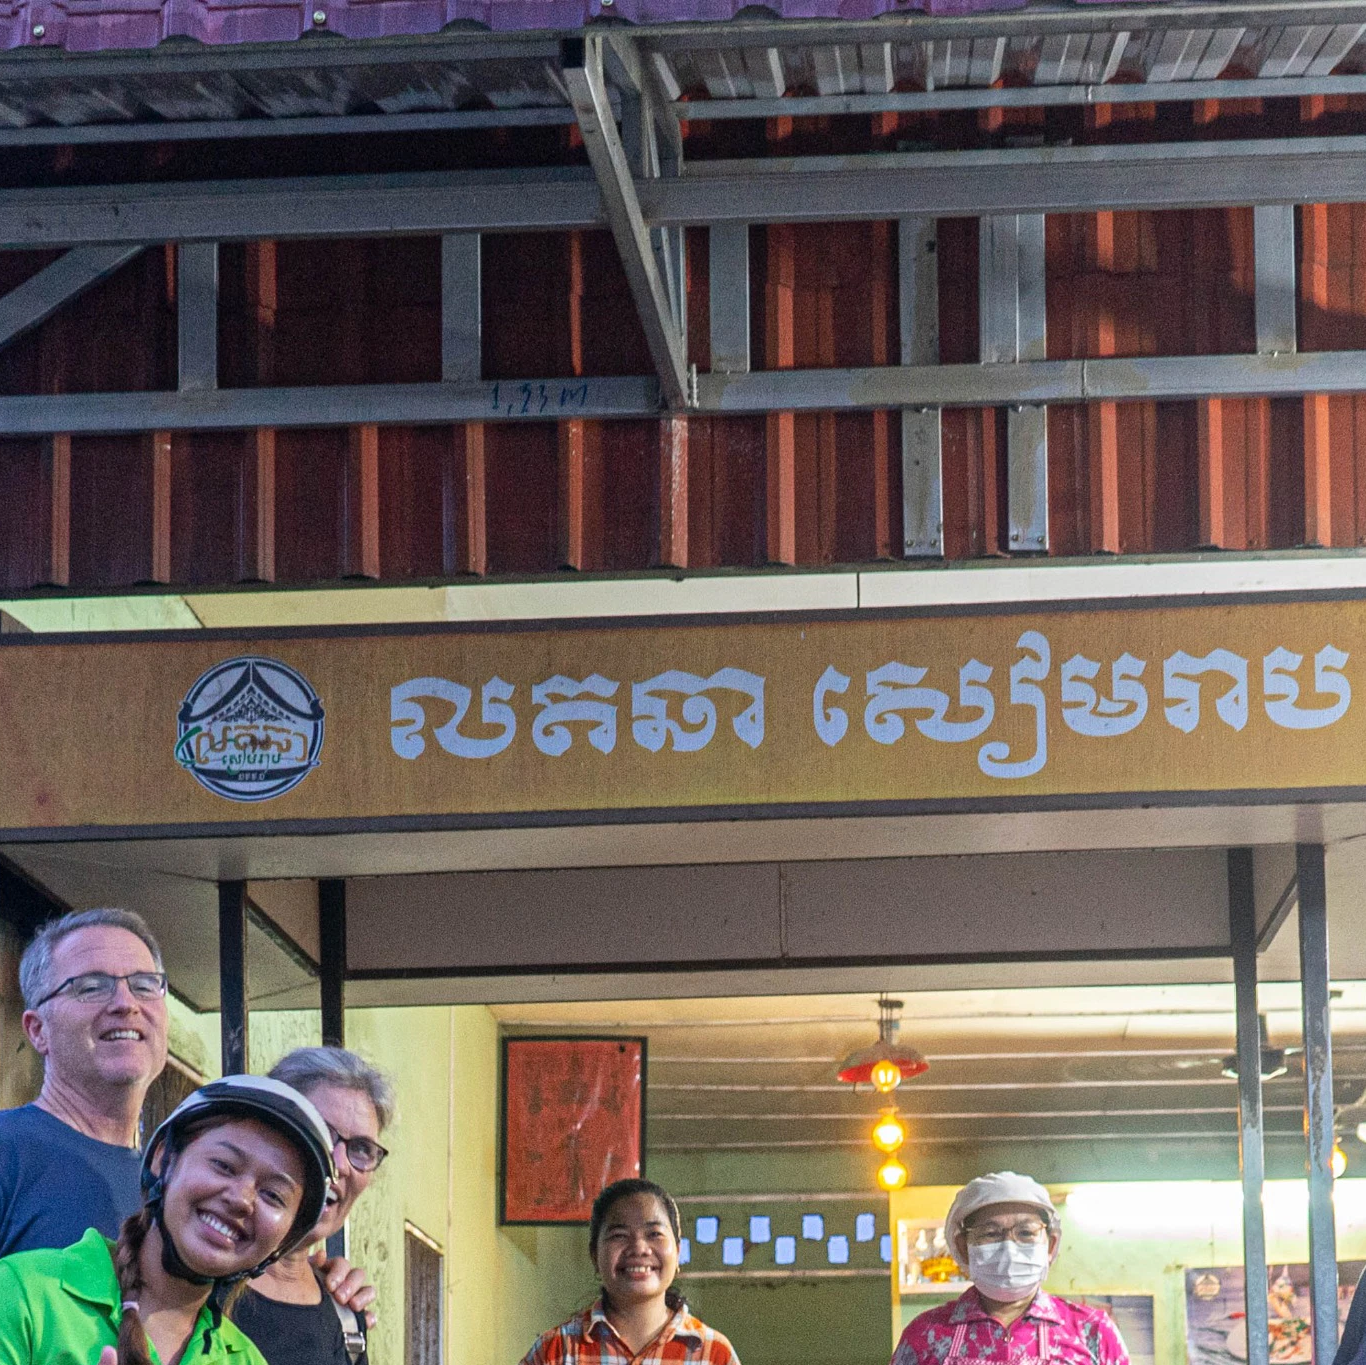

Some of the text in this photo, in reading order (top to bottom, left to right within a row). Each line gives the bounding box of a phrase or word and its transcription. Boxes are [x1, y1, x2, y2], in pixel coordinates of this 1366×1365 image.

[390, 630, 1352, 779] លតឆា សៀមរាប
